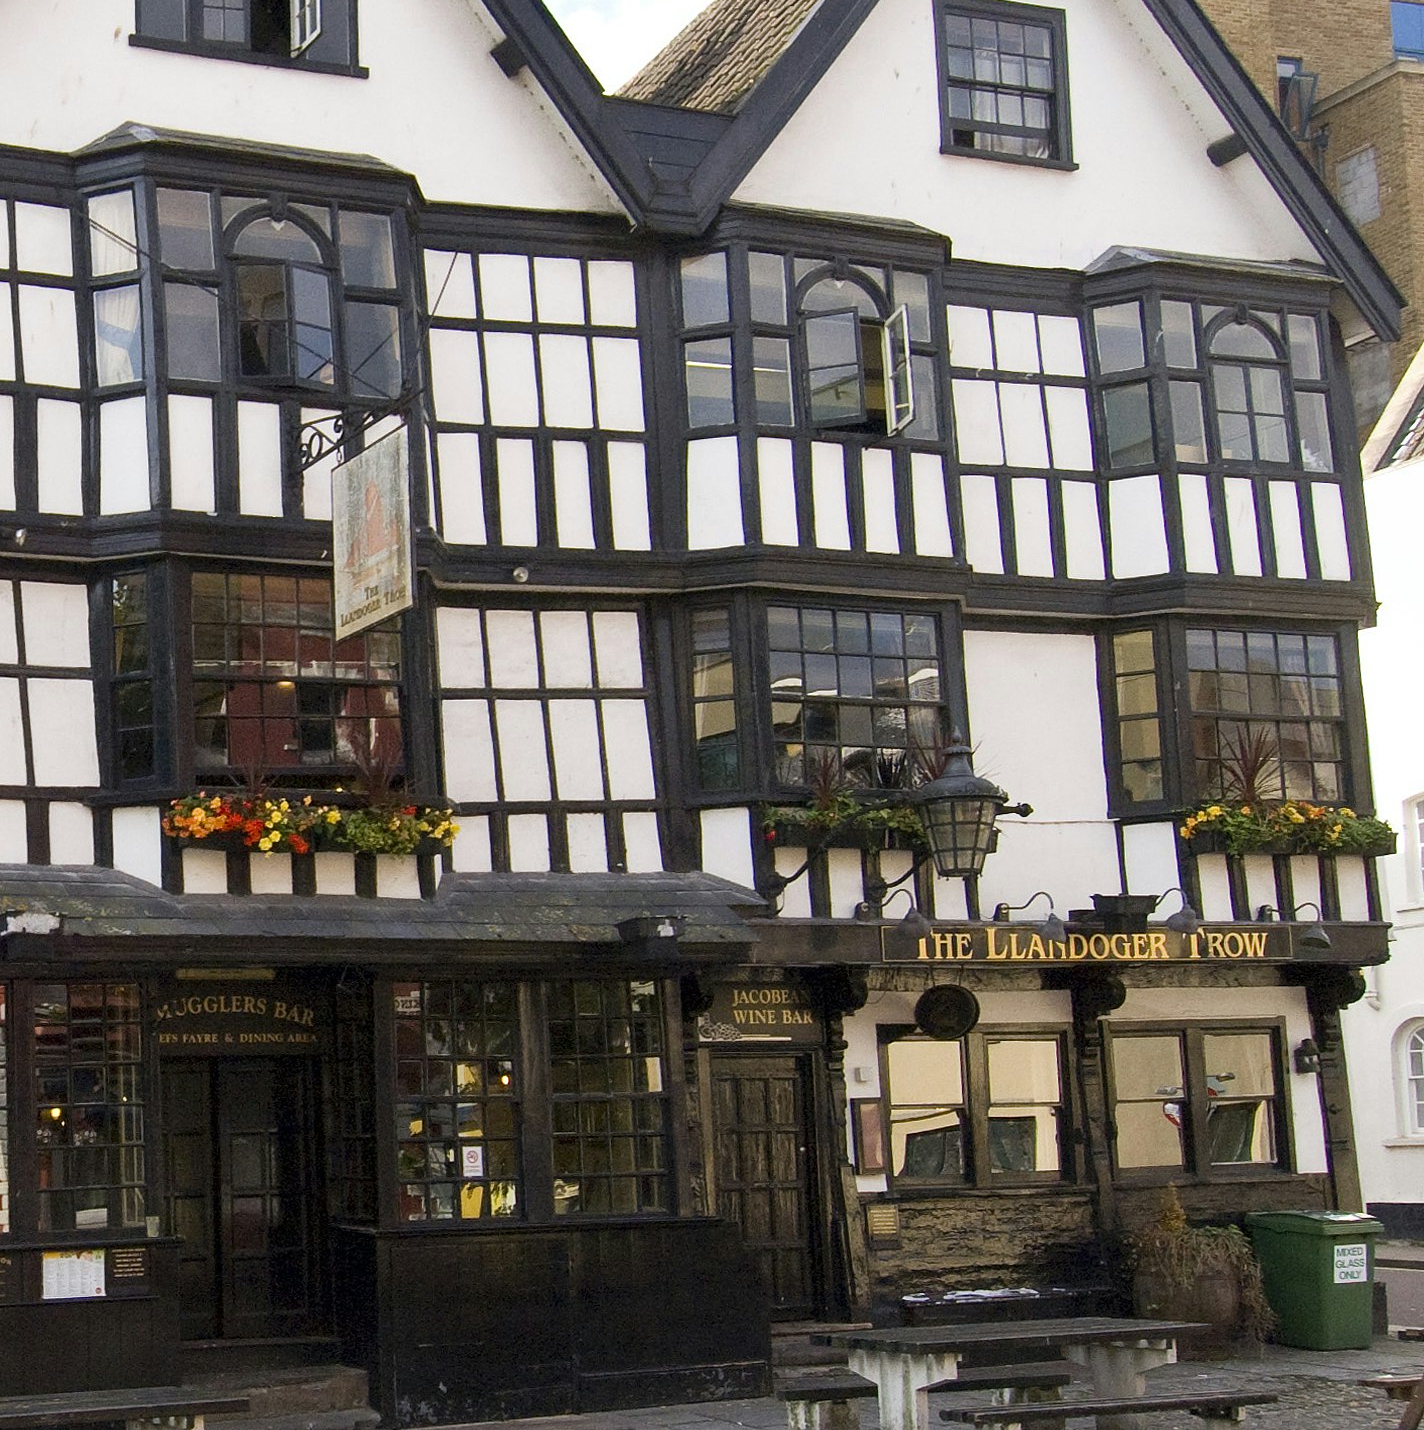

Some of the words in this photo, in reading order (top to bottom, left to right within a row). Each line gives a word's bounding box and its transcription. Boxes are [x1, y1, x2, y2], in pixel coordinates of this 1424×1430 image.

[985, 926, 1170, 960] LLANDOGER
[1182, 926, 1269, 959] TROW
[732, 989, 812, 1007] JACOBEAN
[157, 995, 268, 1021] MUGGLERS
[273, 1001, 315, 1027] BAR
[733, 1010, 777, 1024] WINE
[782, 1010, 813, 1024] BAR
[158, 1033, 178, 1044] EFS
[182, 1033, 219, 1043] FAYRE
[224, 1033, 234, 1043] &
[239, 1033, 284, 1043] DINING
[287, 1033, 318, 1043] AREA
[1336, 1247, 1363, 1257] MIXED
[1336, 1258, 1365, 1268] GLASS
[1339, 1270, 1361, 1280] ONLY
